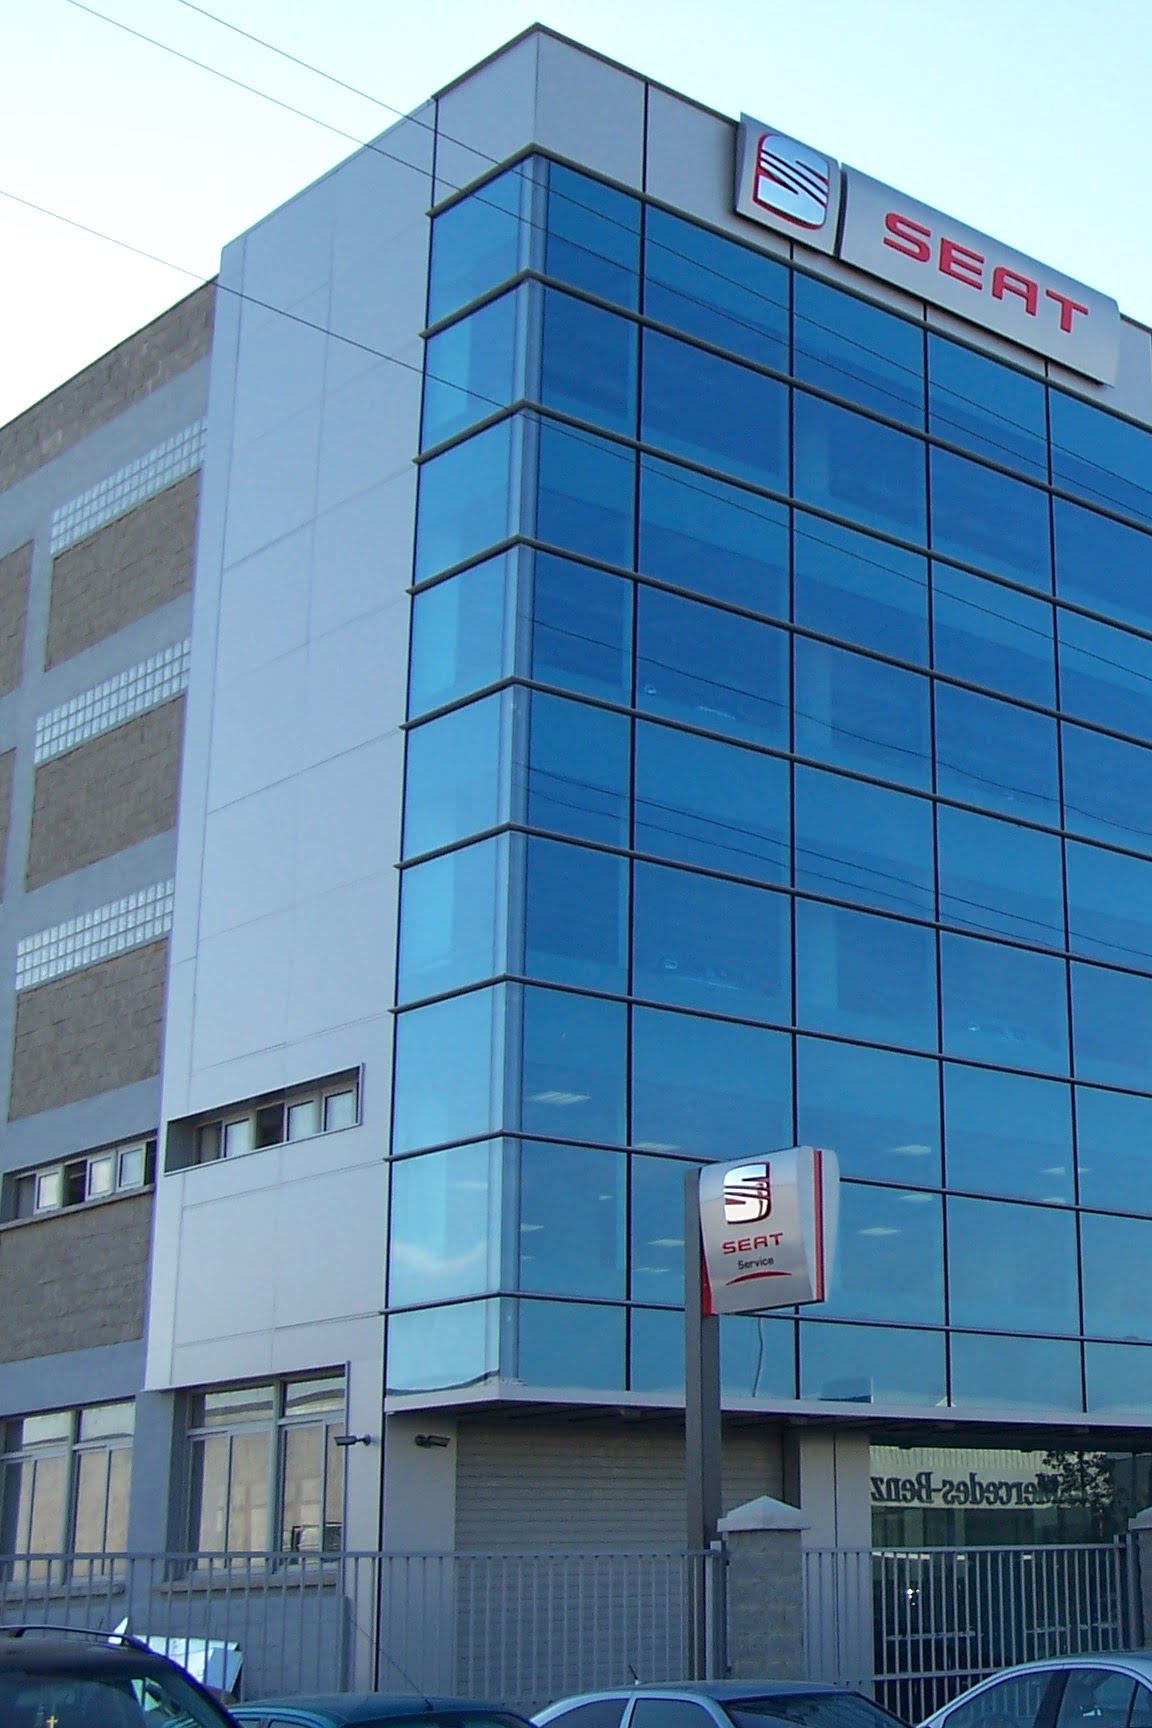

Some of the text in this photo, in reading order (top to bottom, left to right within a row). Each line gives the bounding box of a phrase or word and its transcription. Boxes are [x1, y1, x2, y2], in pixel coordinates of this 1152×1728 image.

[883, 212, 1090, 334] SEAT
[722, 1232, 784, 1255] SEAT
[737, 1256, 775, 1271] Service
